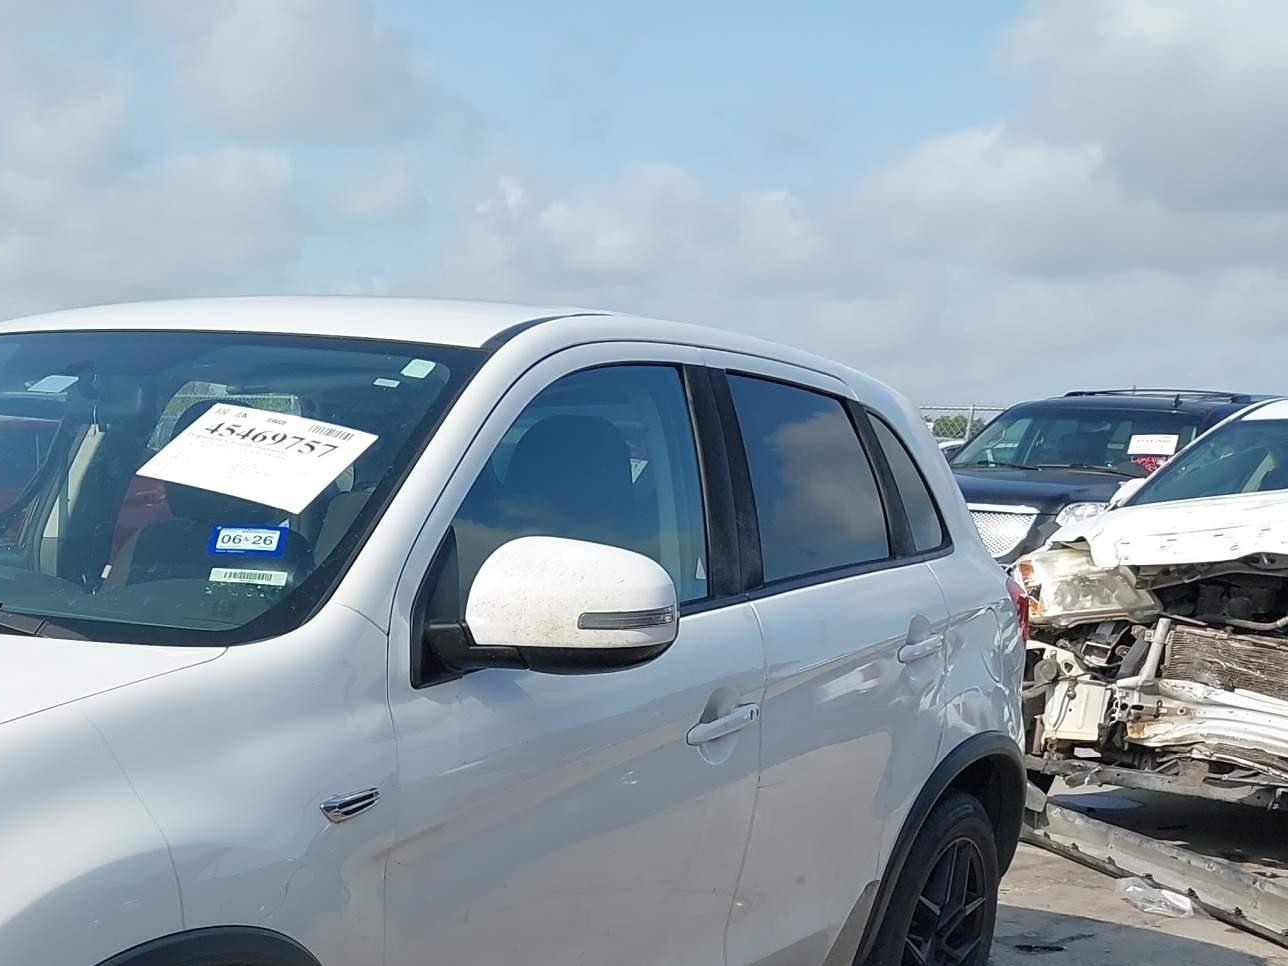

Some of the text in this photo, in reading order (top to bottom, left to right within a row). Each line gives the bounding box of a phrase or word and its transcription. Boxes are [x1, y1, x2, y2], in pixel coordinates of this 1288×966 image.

[205, 421, 339, 458] 45469757
[221, 534, 274, 546] 06 26
